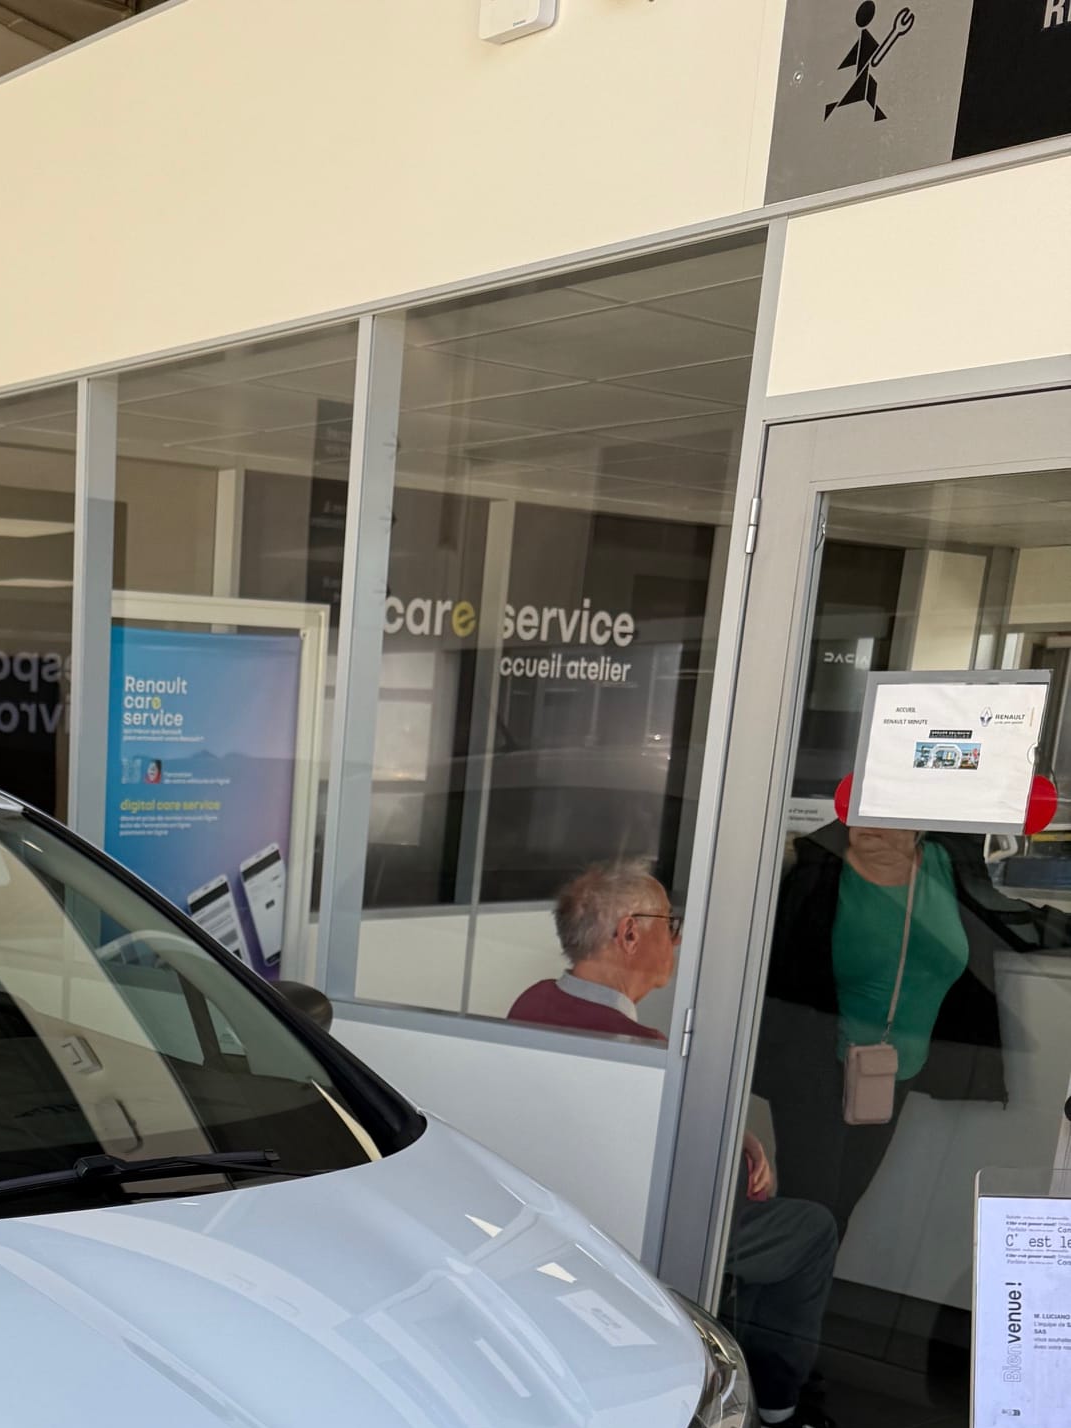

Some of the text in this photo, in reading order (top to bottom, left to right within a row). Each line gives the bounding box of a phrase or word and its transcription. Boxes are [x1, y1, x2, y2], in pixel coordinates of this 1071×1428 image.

[383, 595, 635, 647] care service
[824, 652, 870, 665] DACIA
[500, 653, 631, 682] ccueil atelier
[124, 676, 188, 695] Renault
[124, 696, 162, 710] care
[123, 709, 184, 727] service
[120, 799, 156, 815] digital
[182, 801, 222, 811] service
[1028, 1235, 1052, 1248] est
